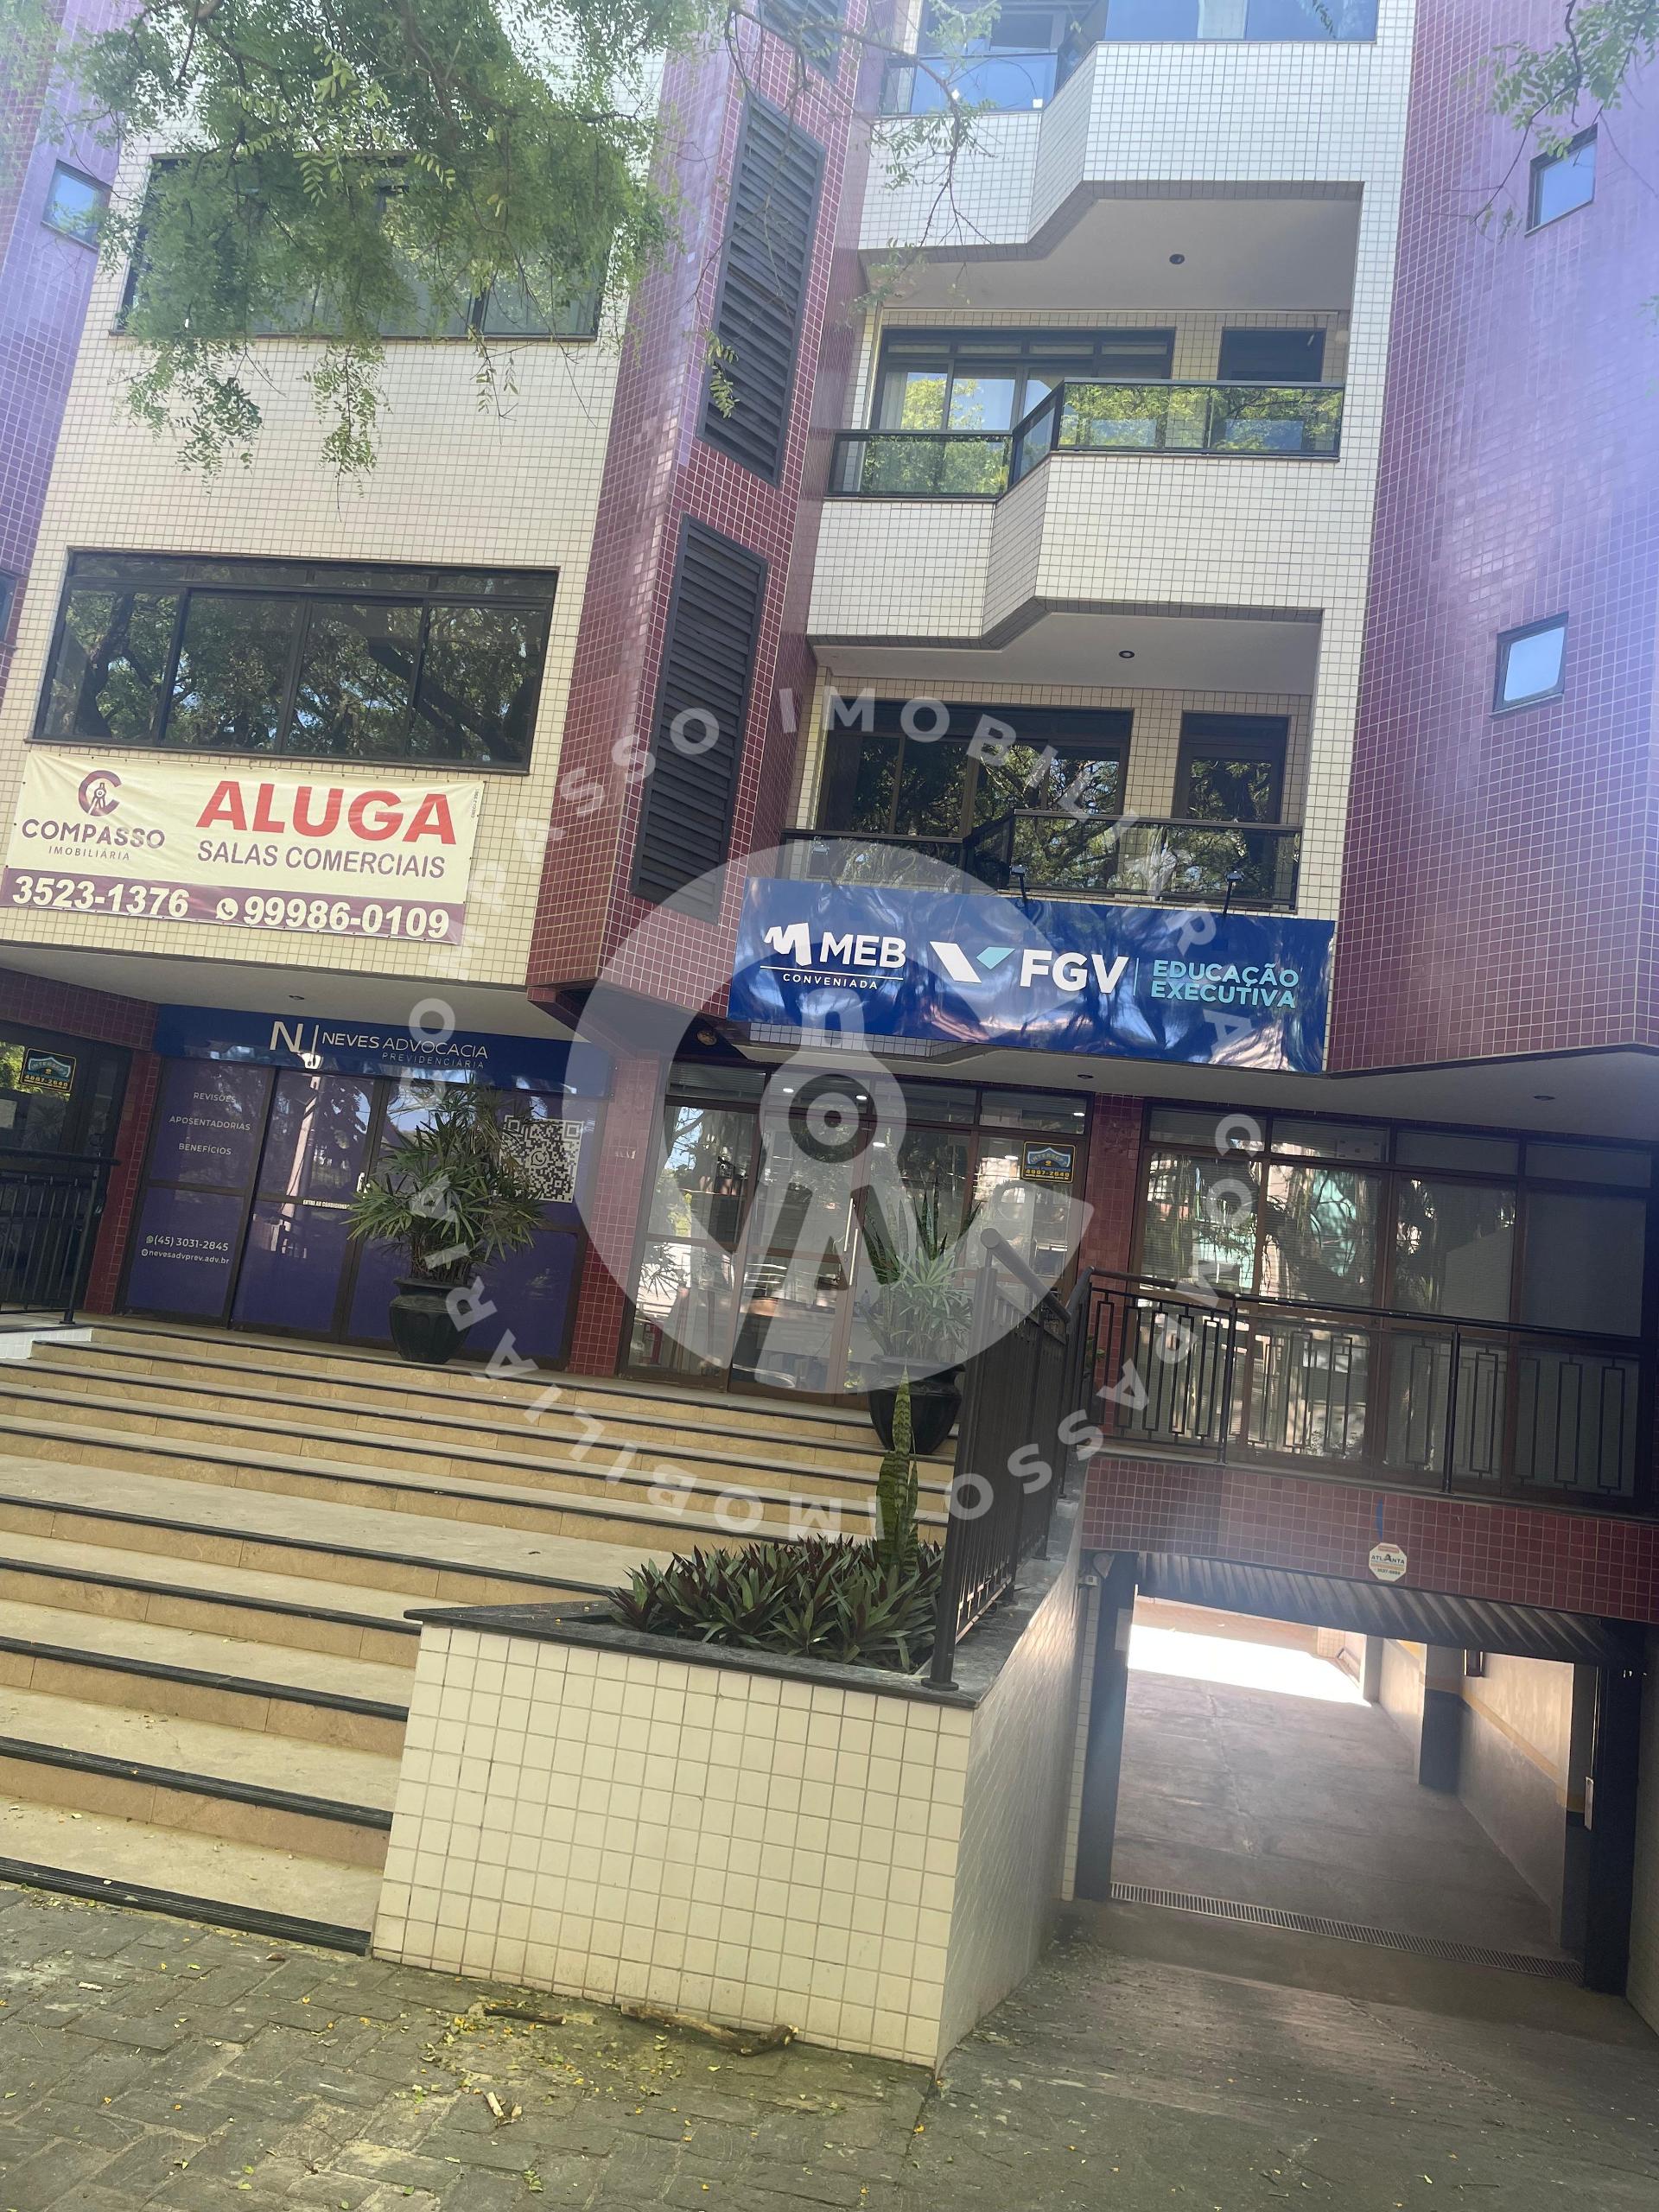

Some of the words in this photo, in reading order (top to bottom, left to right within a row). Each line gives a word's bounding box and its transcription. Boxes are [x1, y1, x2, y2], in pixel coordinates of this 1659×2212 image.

[196, 780, 457, 845] ALUGA
[22, 818, 166, 849] COMPASSO
[48, 844, 130, 861] IMOBILIÁRIA
[197, 840, 279, 867] SALAS
[285, 846, 446, 879] COMERCIAIS
[12, 874, 191, 918] 3523-1376
[243, 895, 449, 939] 99986-0109
[819, 931, 906, 969] MEB
[782, 973, 878, 990] CONVENIADA
[1020, 949, 1129, 994] FGV
[1152, 958, 1299, 988] EDUCAÇÃO
[1150, 980, 1296, 1009] EXECUTIVA
[321, 1031, 381, 1049] NEVES
[382, 1037, 489, 1059] ADVOCACIA
[168, 1115, 251, 1131] APOSENTADORIAS
[178, 1142, 232, 1155] BENEFÍCIOS
[154, 1234, 175, 1248] (45)
[175, 1237, 229, 1252] 3031-2845
[1371, 1554, 1405, 1564] ATLANTA
